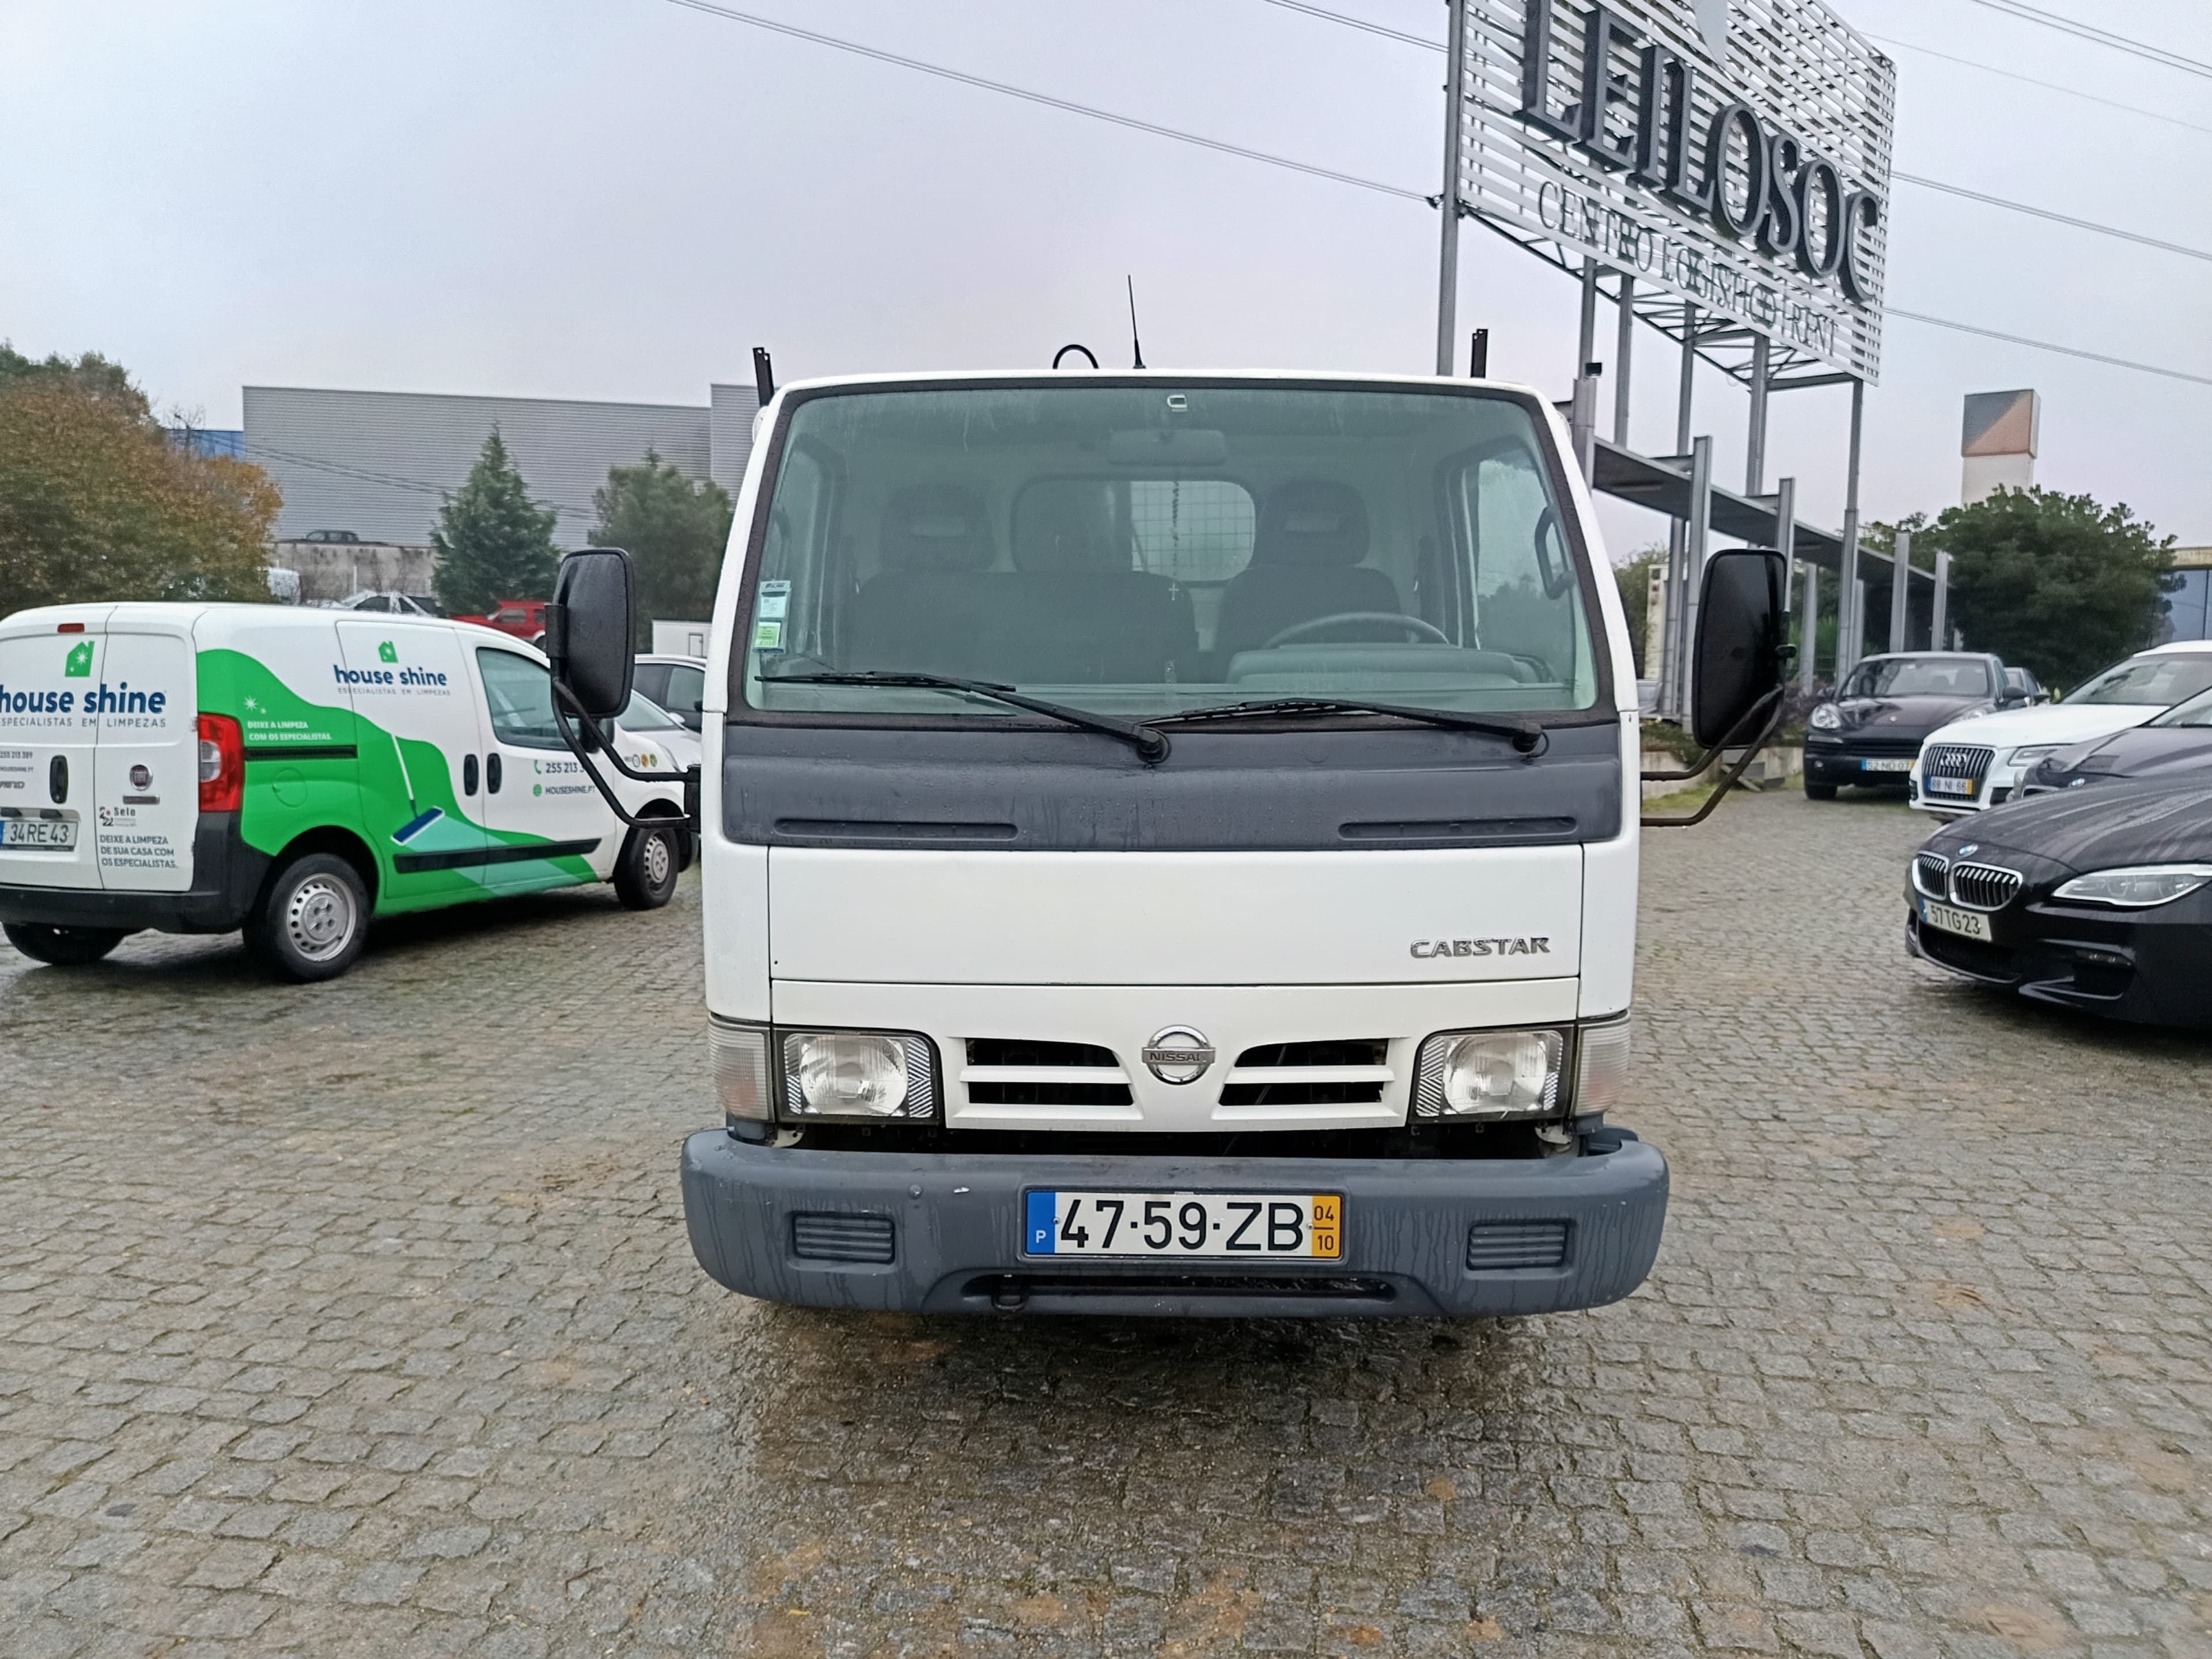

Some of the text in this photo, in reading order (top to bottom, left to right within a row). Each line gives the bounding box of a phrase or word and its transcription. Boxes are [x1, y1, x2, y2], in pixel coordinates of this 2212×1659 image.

[1513, 0, 1879, 301] LEILOSOC
[1539, 181, 1653, 273] CENTRO
[333, 664, 447, 686] house shine
[0, 681, 166, 713] house shine
[82, 718, 97, 727] EM
[107, 718, 166, 728] LIMPEZAS
[249, 733, 267, 741] COM
[546, 763, 562, 774] 255
[564, 763, 578, 773] 213
[546, 785, 595, 795] HOUSESHINE.PT
[114, 807, 136, 817] Selo
[100, 835, 124, 843] DEIXE
[132, 836, 169, 844] LIMPEZA
[101, 846, 112, 855] DE
[130, 847, 153, 856] CASA
[154, 849, 175, 857] COM
[101, 858, 113, 866] OS
[1410, 937, 1551, 959] CABSTAR
[1313, 1205, 1335, 1221] 04
[1036, 1230, 1046, 1243] P
[1317, 1234, 1334, 1251] 10
